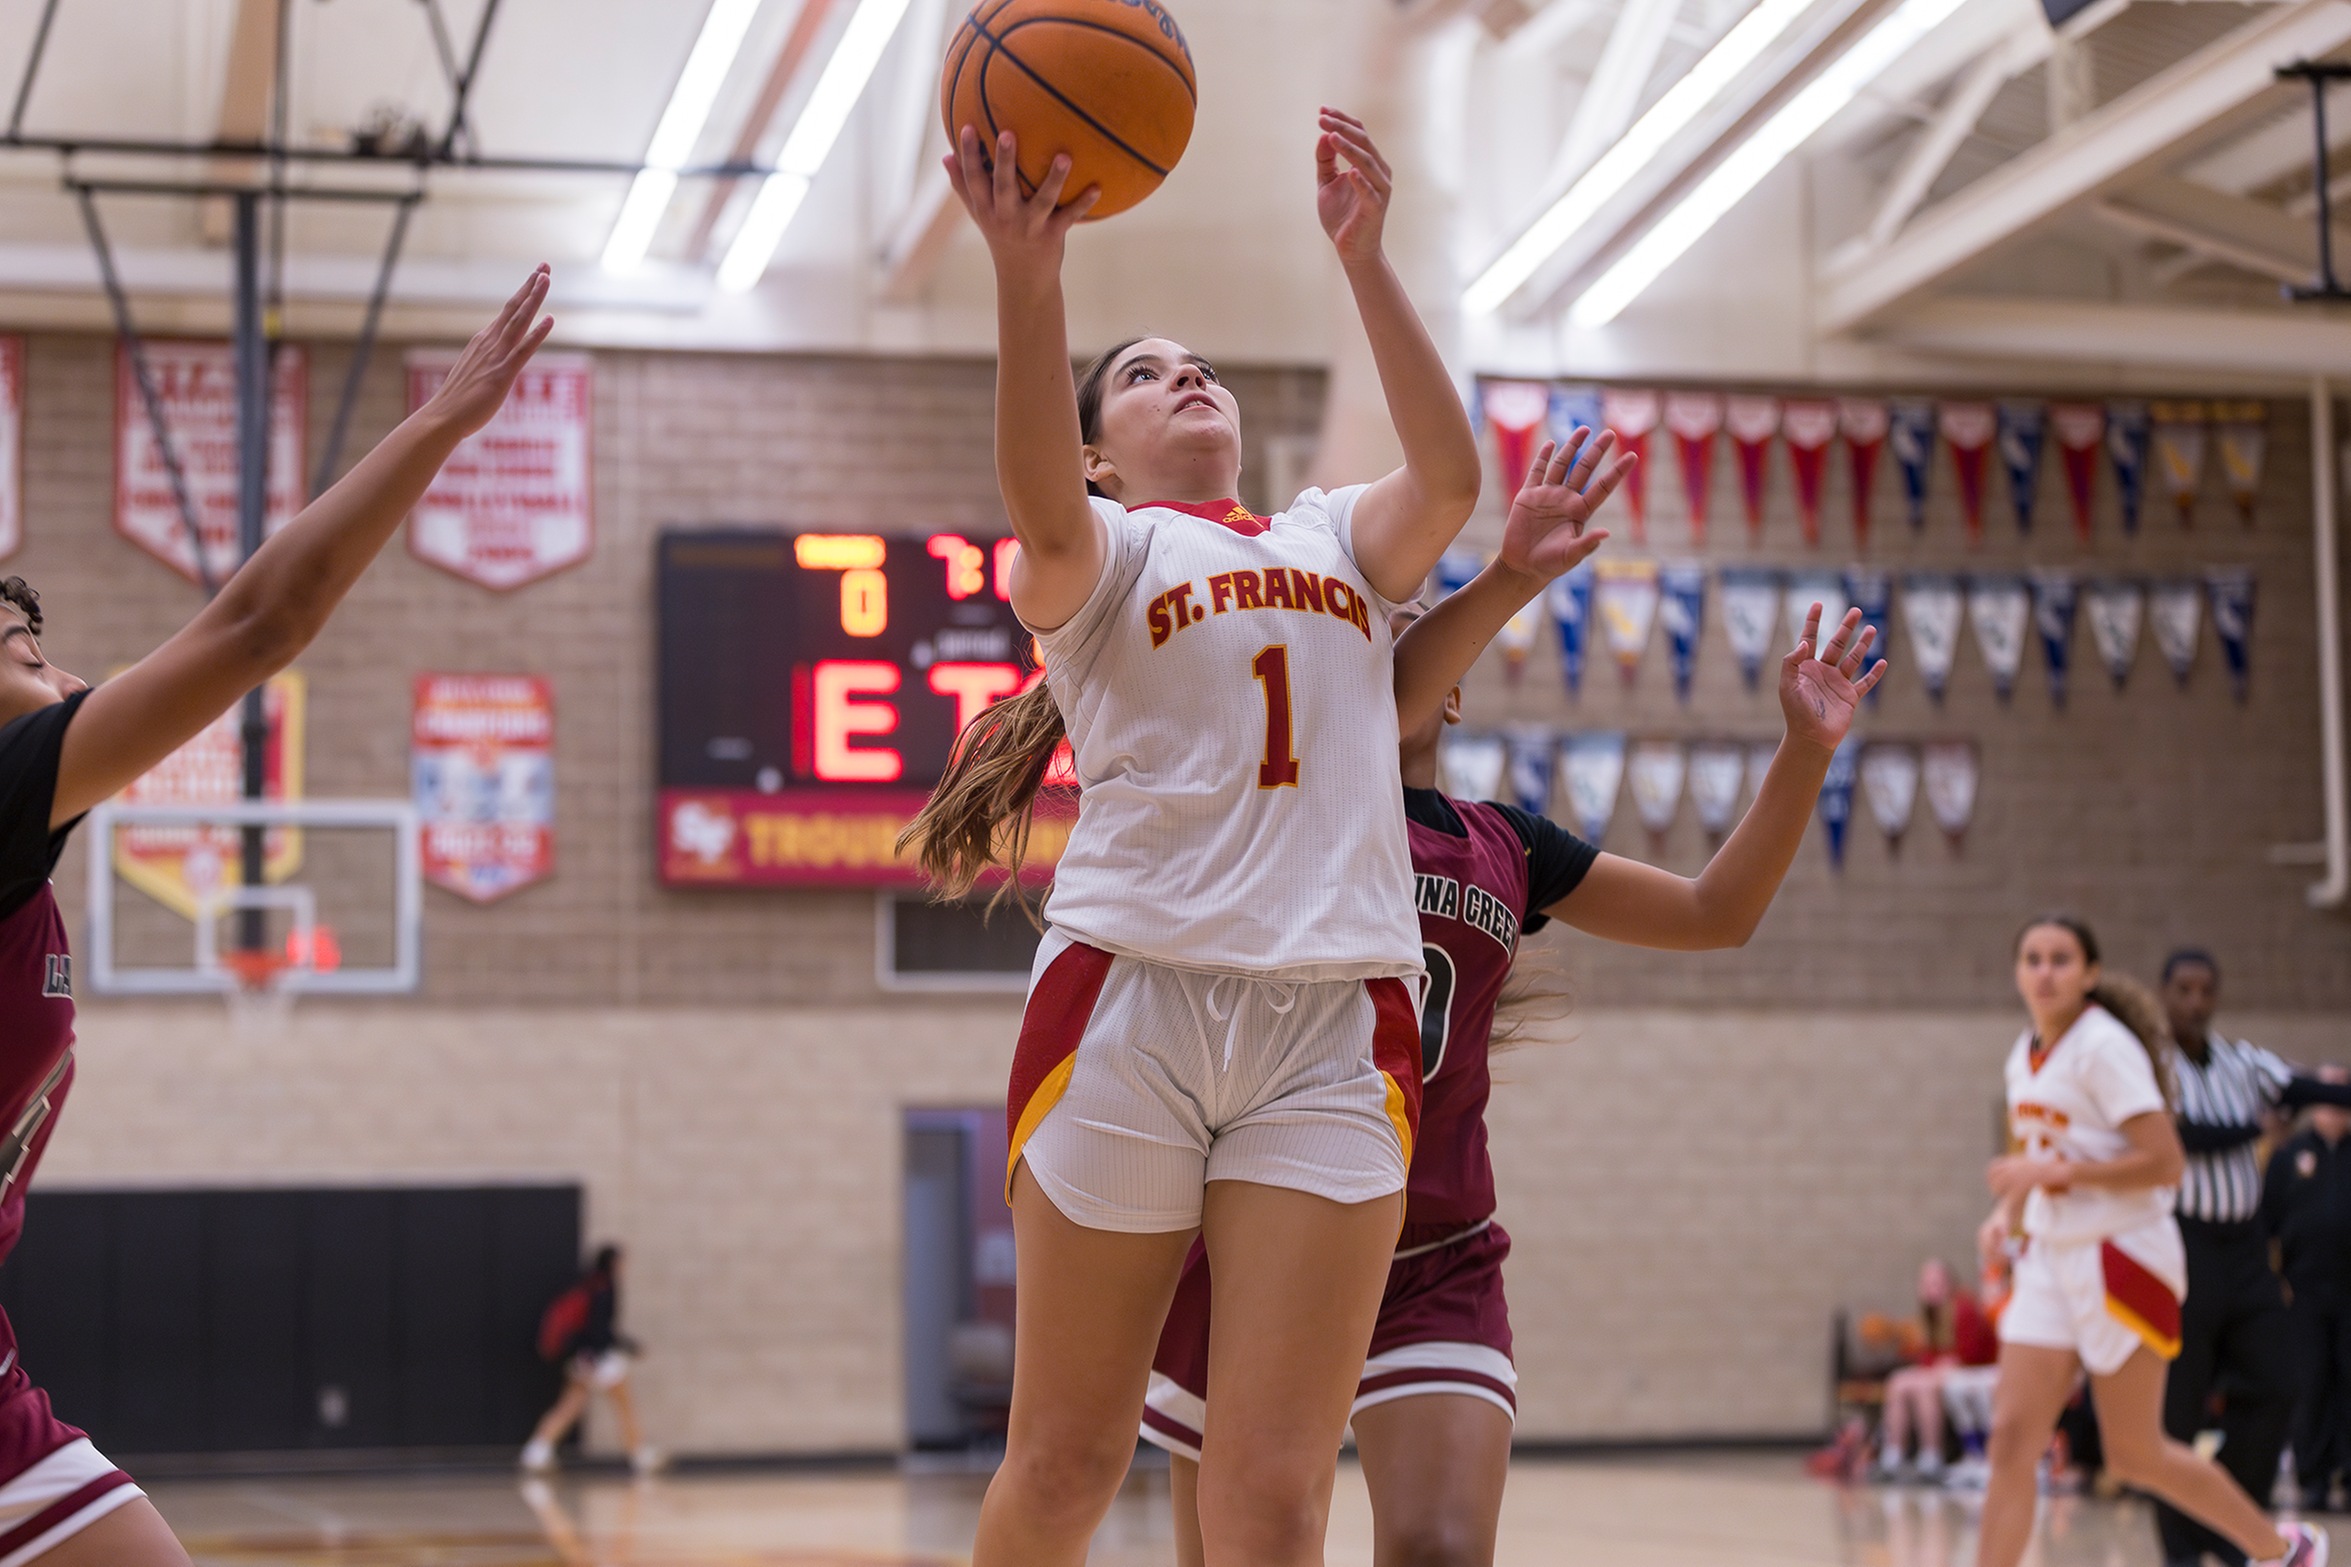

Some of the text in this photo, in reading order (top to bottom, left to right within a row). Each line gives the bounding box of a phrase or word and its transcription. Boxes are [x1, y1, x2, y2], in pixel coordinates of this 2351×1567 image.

[1146, 567, 1372, 650] ST. FRANCIS
[1251, 643, 1300, 789] 1
